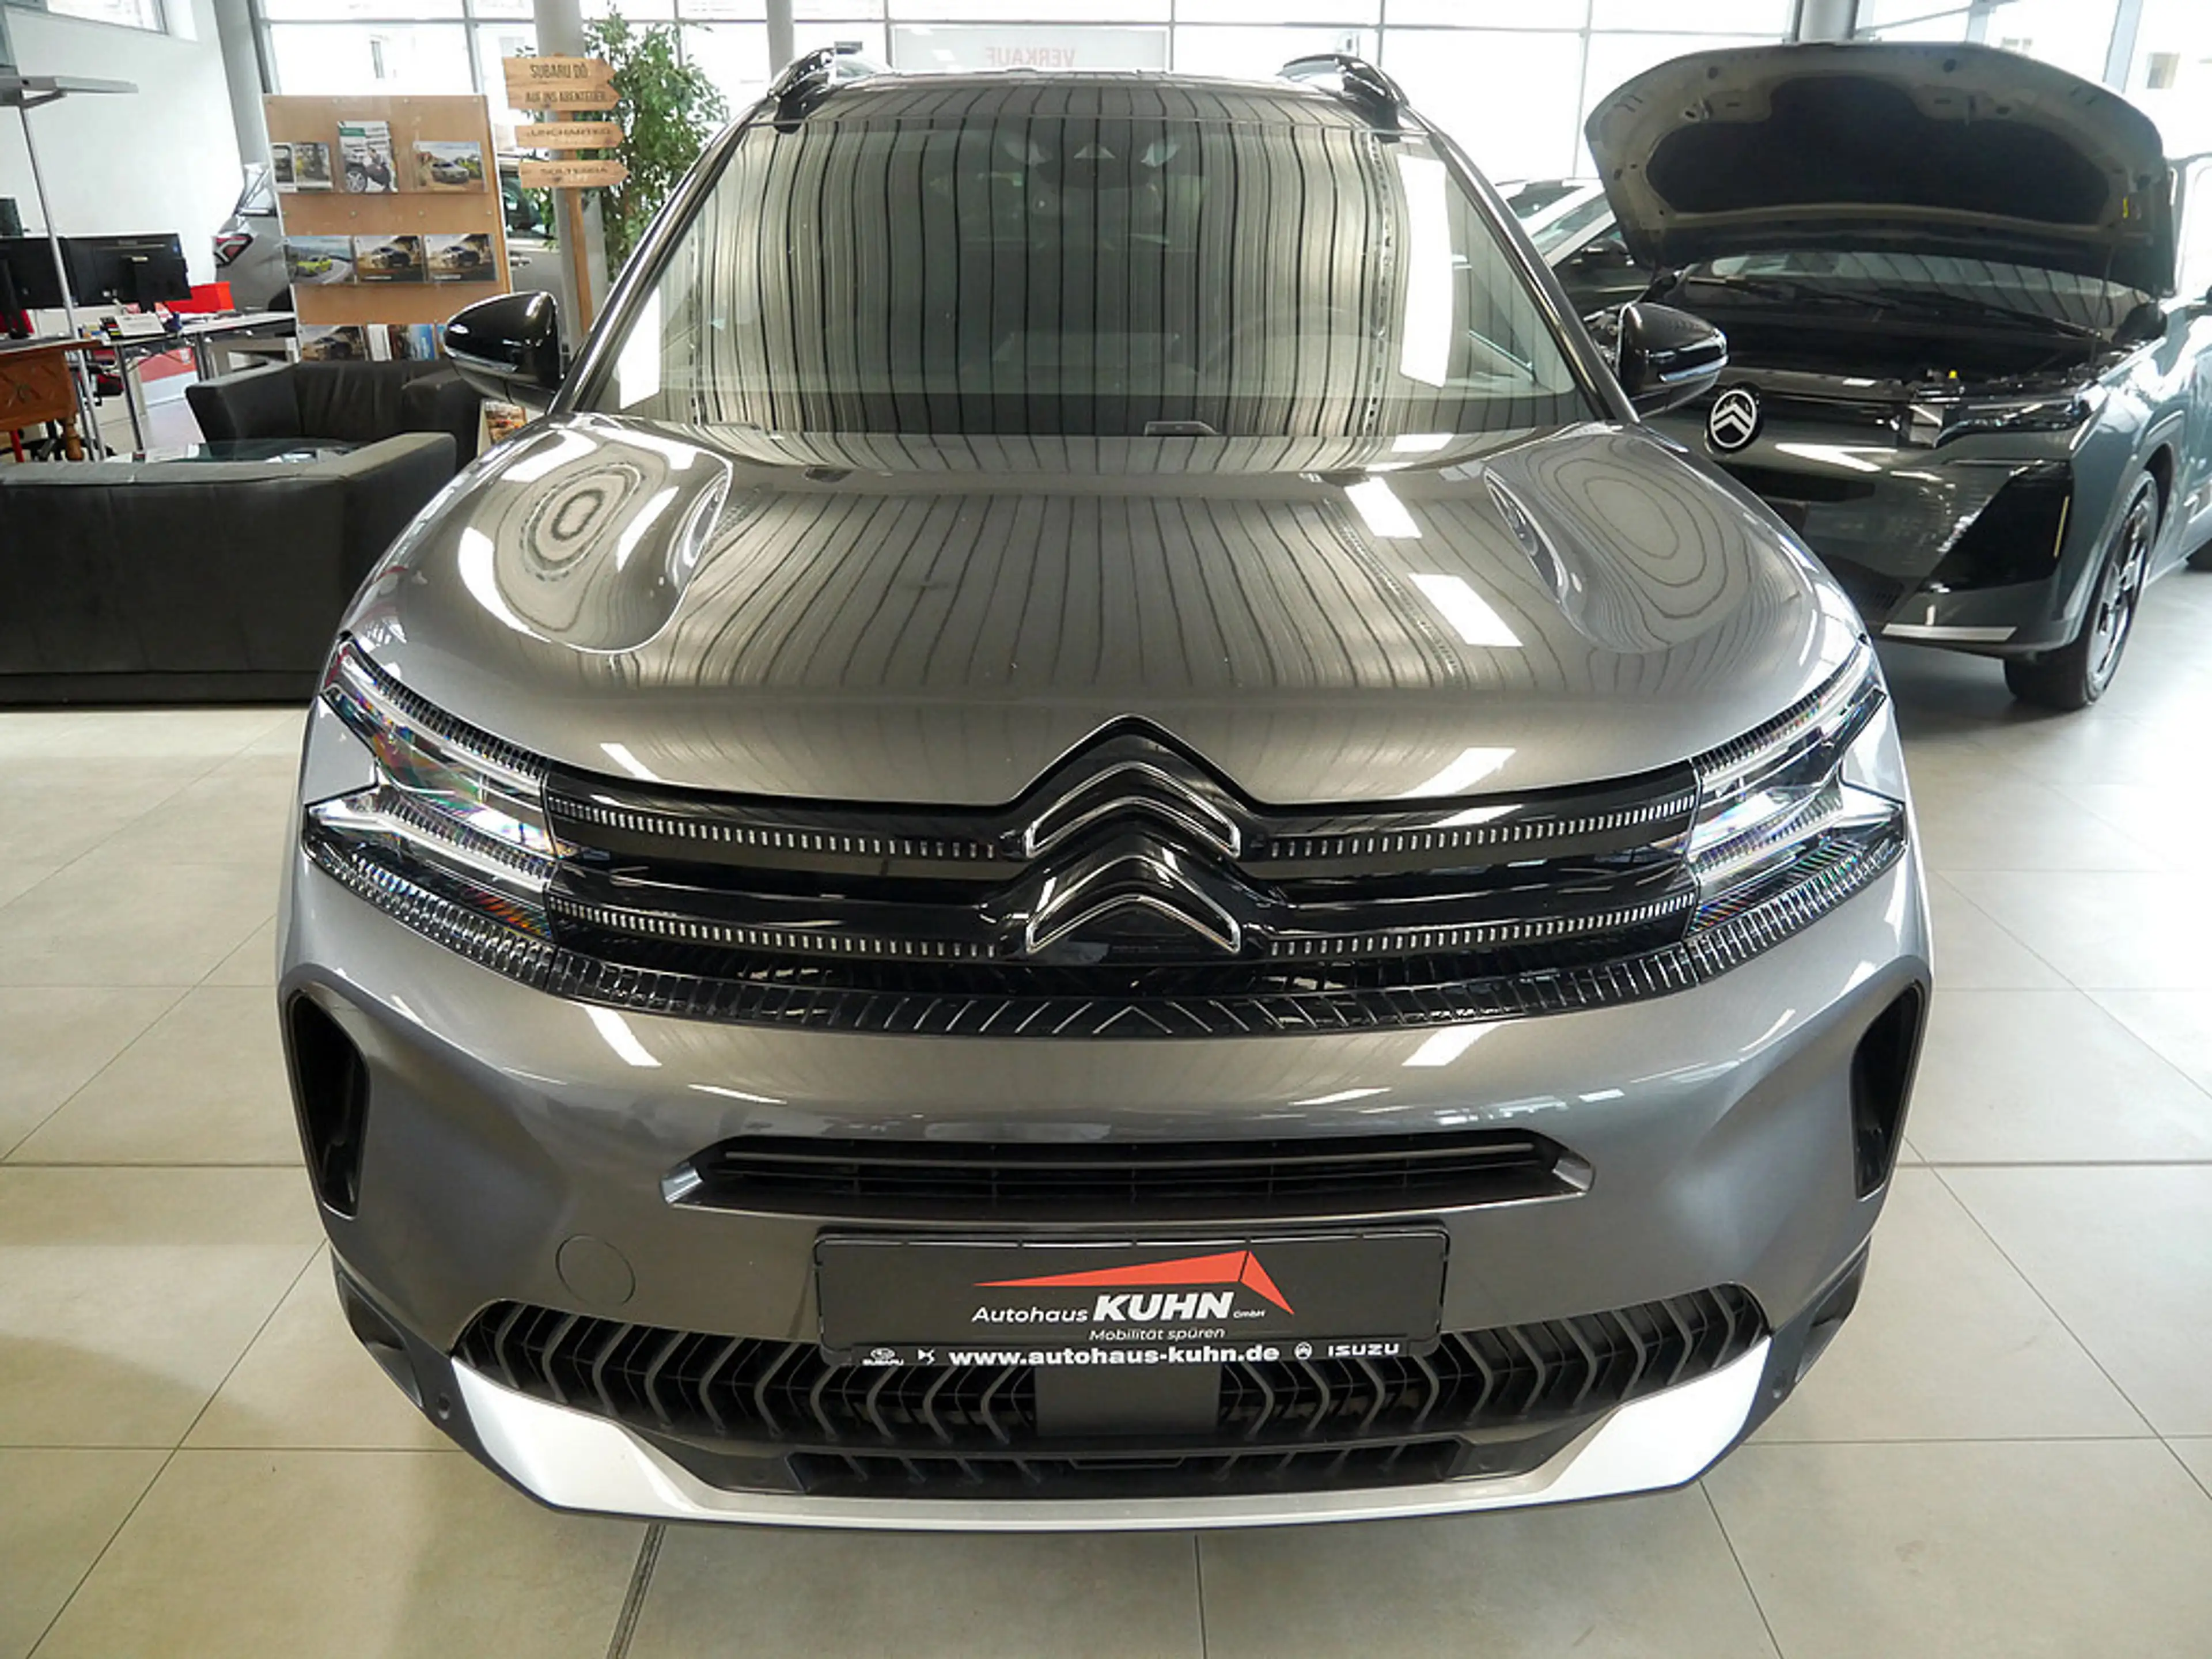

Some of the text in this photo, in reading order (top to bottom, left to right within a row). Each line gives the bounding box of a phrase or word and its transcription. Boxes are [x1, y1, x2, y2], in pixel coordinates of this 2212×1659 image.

[529, 64, 571, 78] SUBARU
[543, 91, 558, 103] INS
[971, 1307, 1089, 1323] Autohaus
[1093, 1291, 1234, 1321] KUHN
[1088, 1327, 1226, 1342] Mobilität spüren
[949, 1344, 1280, 1366] www.autohaus-kuhn.de
[1328, 1343, 1400, 1357] ISUZU
